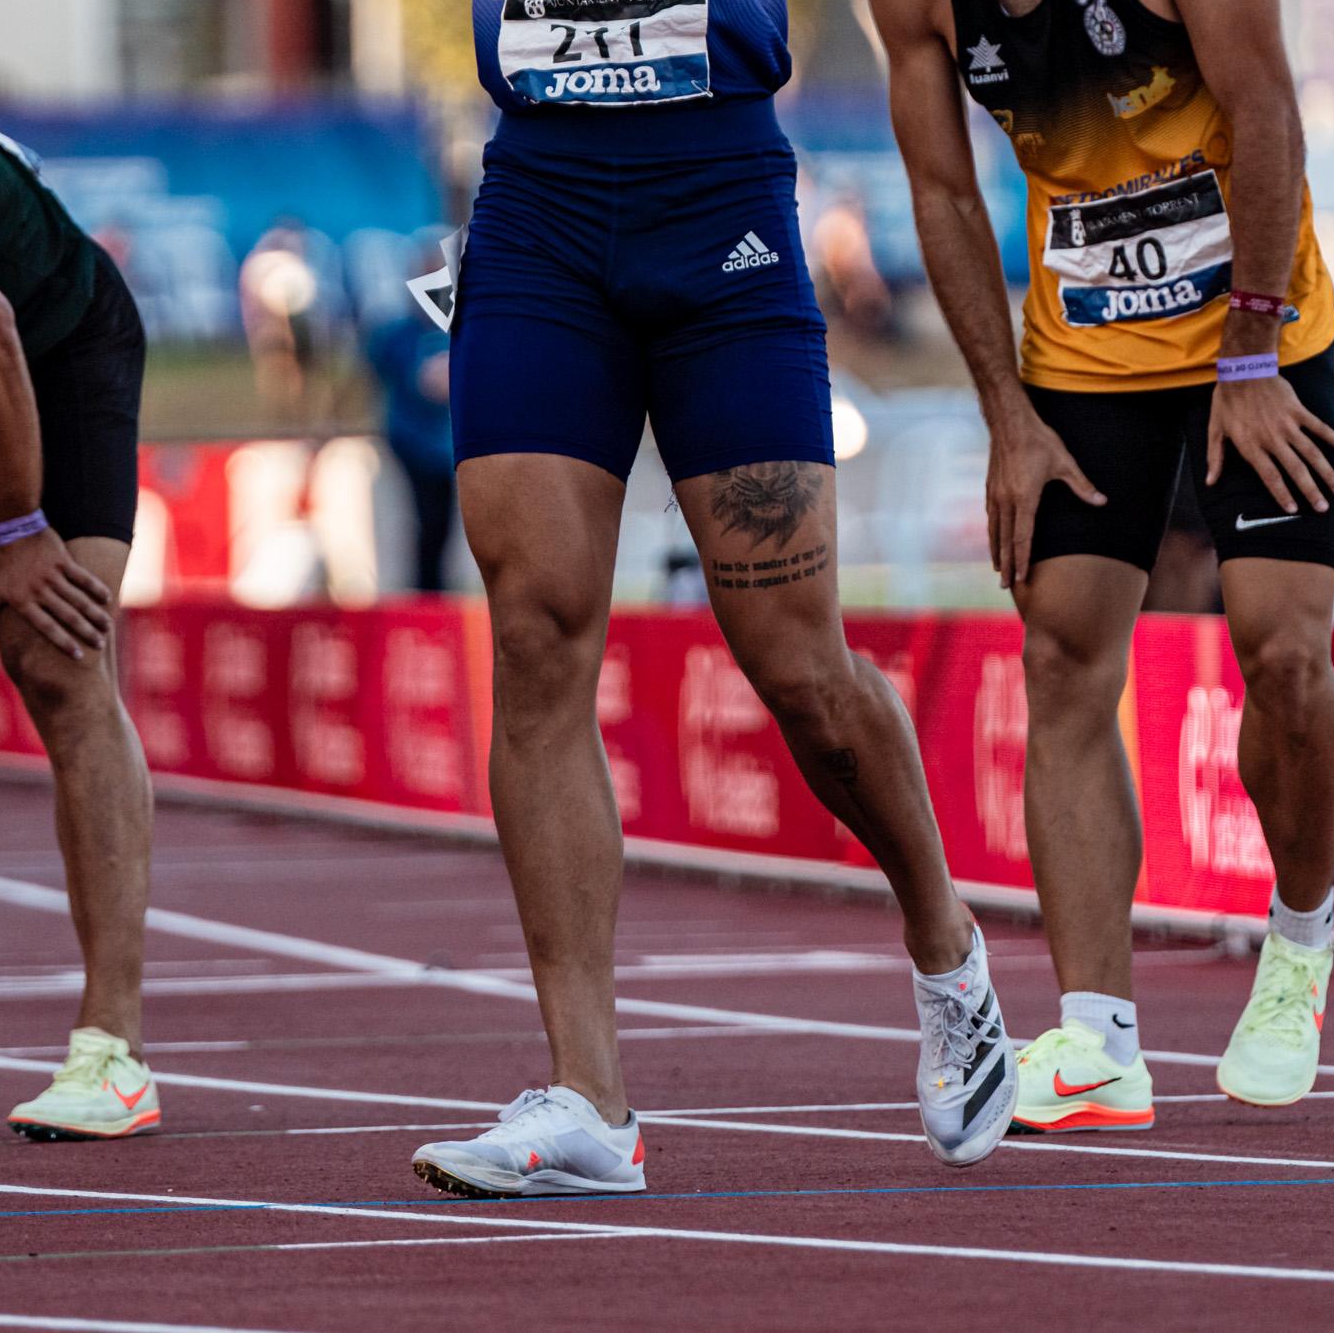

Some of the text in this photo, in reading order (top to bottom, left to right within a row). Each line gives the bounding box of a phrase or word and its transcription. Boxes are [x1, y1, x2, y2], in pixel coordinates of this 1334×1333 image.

[550, 21, 644, 64] 211
[722, 252, 779, 271] adidas
[1109, 236, 1168, 282] 40
